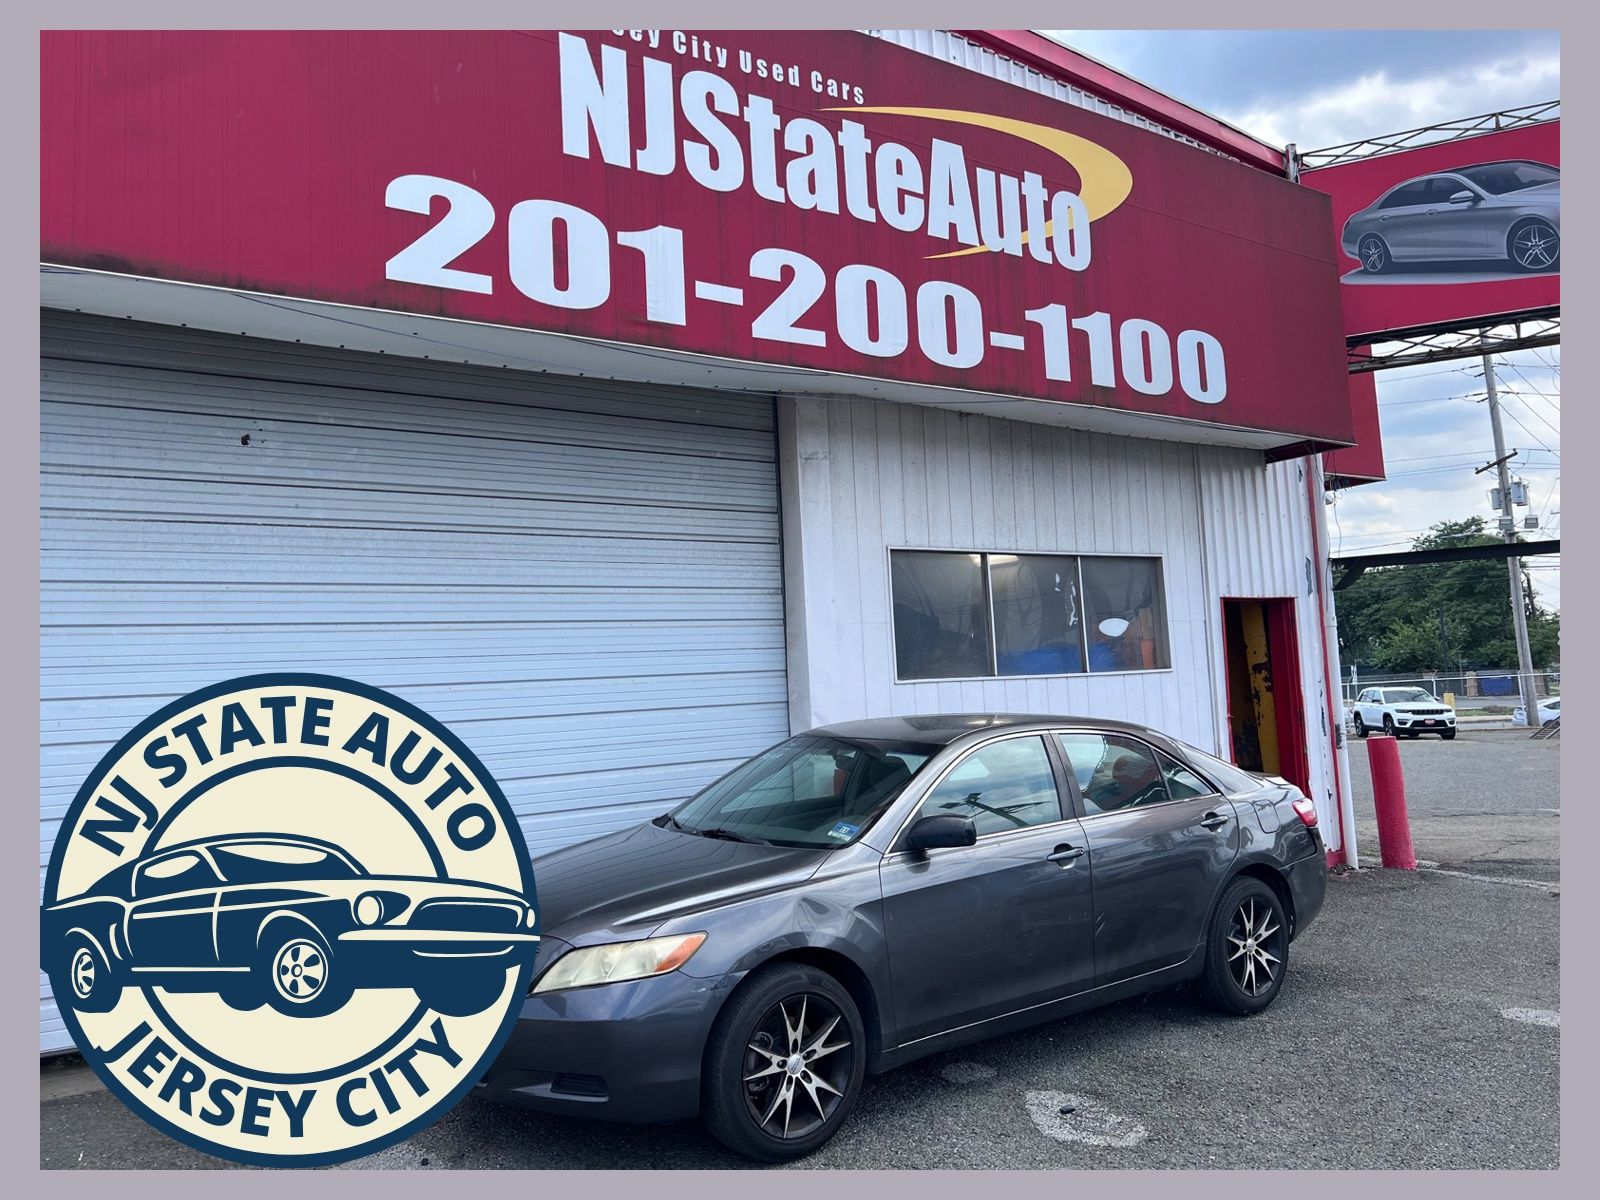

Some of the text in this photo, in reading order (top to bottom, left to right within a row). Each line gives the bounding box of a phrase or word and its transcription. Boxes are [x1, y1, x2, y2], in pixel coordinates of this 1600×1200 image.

[559, 32, 1092, 271] NJStateAuto
[673, 31, 728, 68] City
[739, 49, 800, 87] Used
[811, 70, 864, 105] Cars
[385, 175, 1226, 404] 201-200-1100
